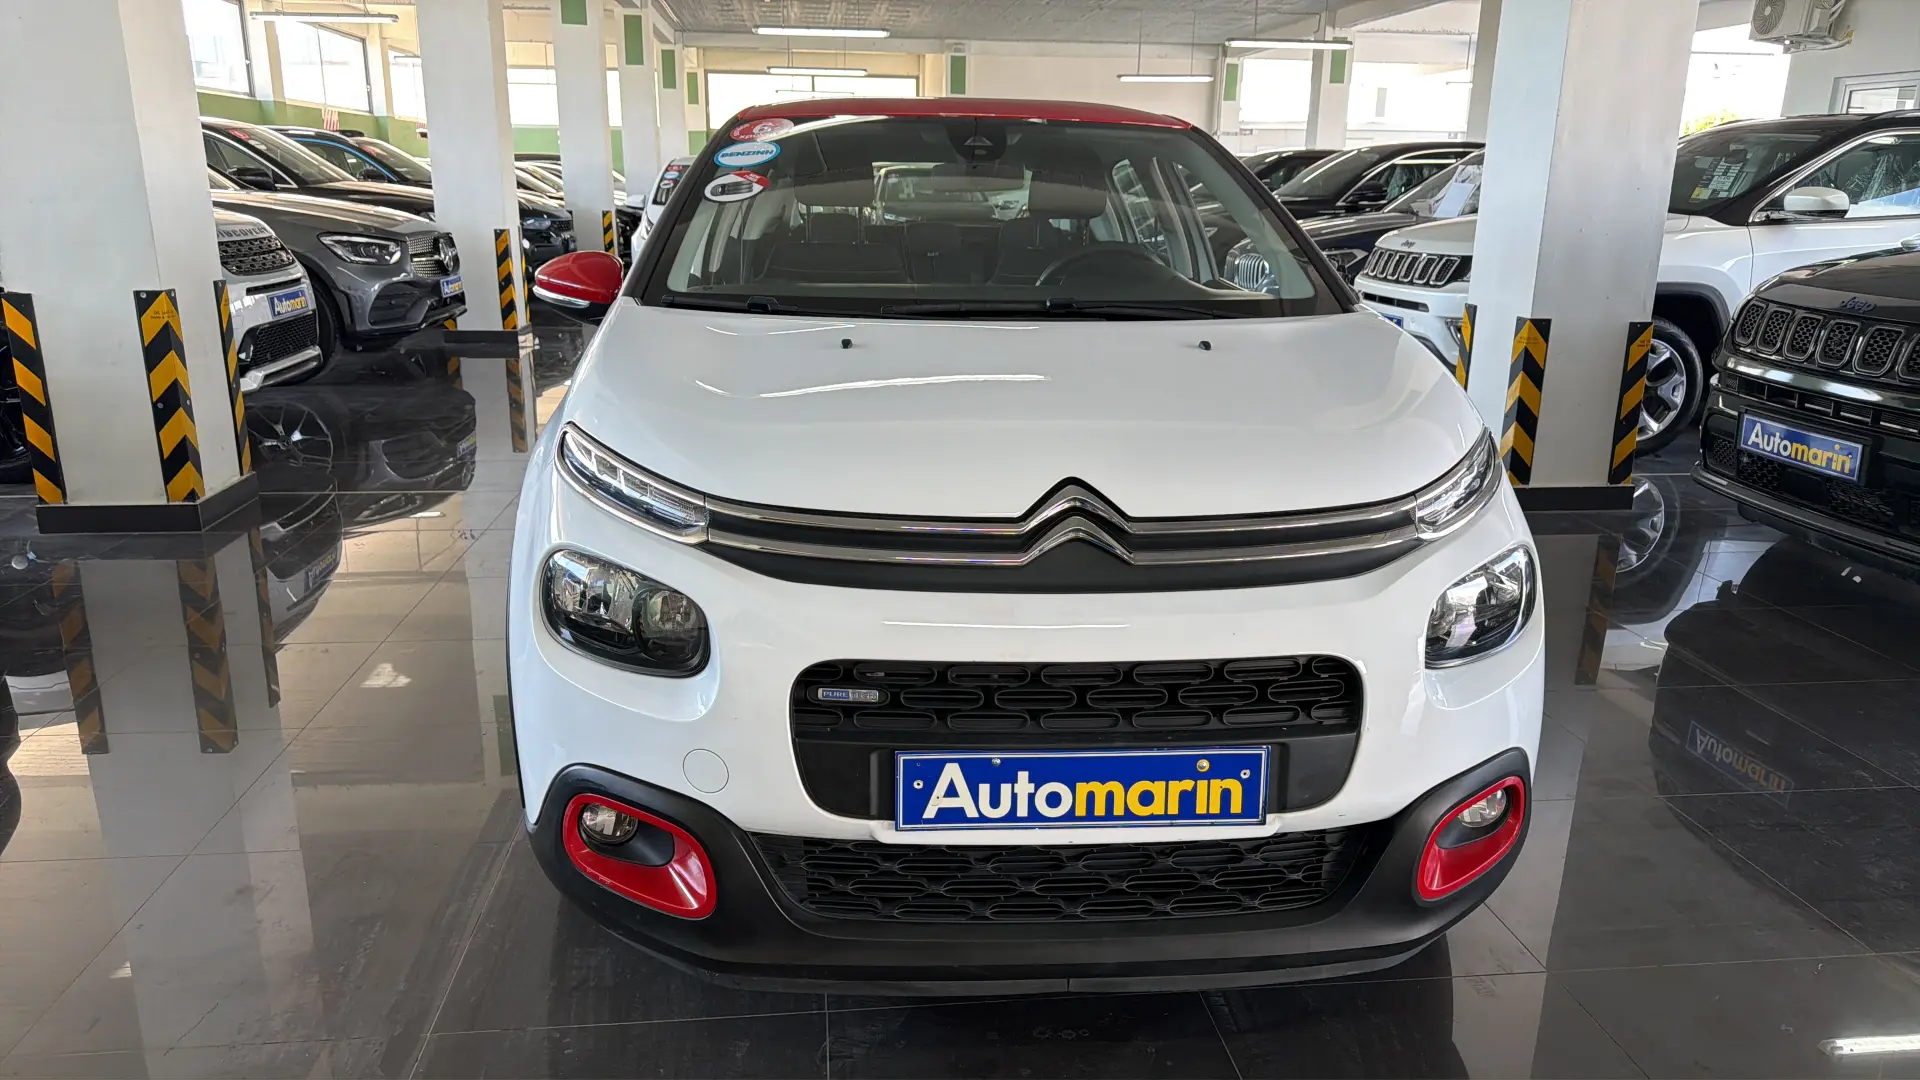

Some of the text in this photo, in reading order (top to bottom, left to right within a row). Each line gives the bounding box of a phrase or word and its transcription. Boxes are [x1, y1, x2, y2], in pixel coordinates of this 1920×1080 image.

[274, 291, 307, 315] Automarin
[1841, 297, 1876, 313] Jeep
[1748, 423, 1852, 474] Automarin
[823, 690, 849, 698] PURE
[922, 760, 1242, 819] Automarin
